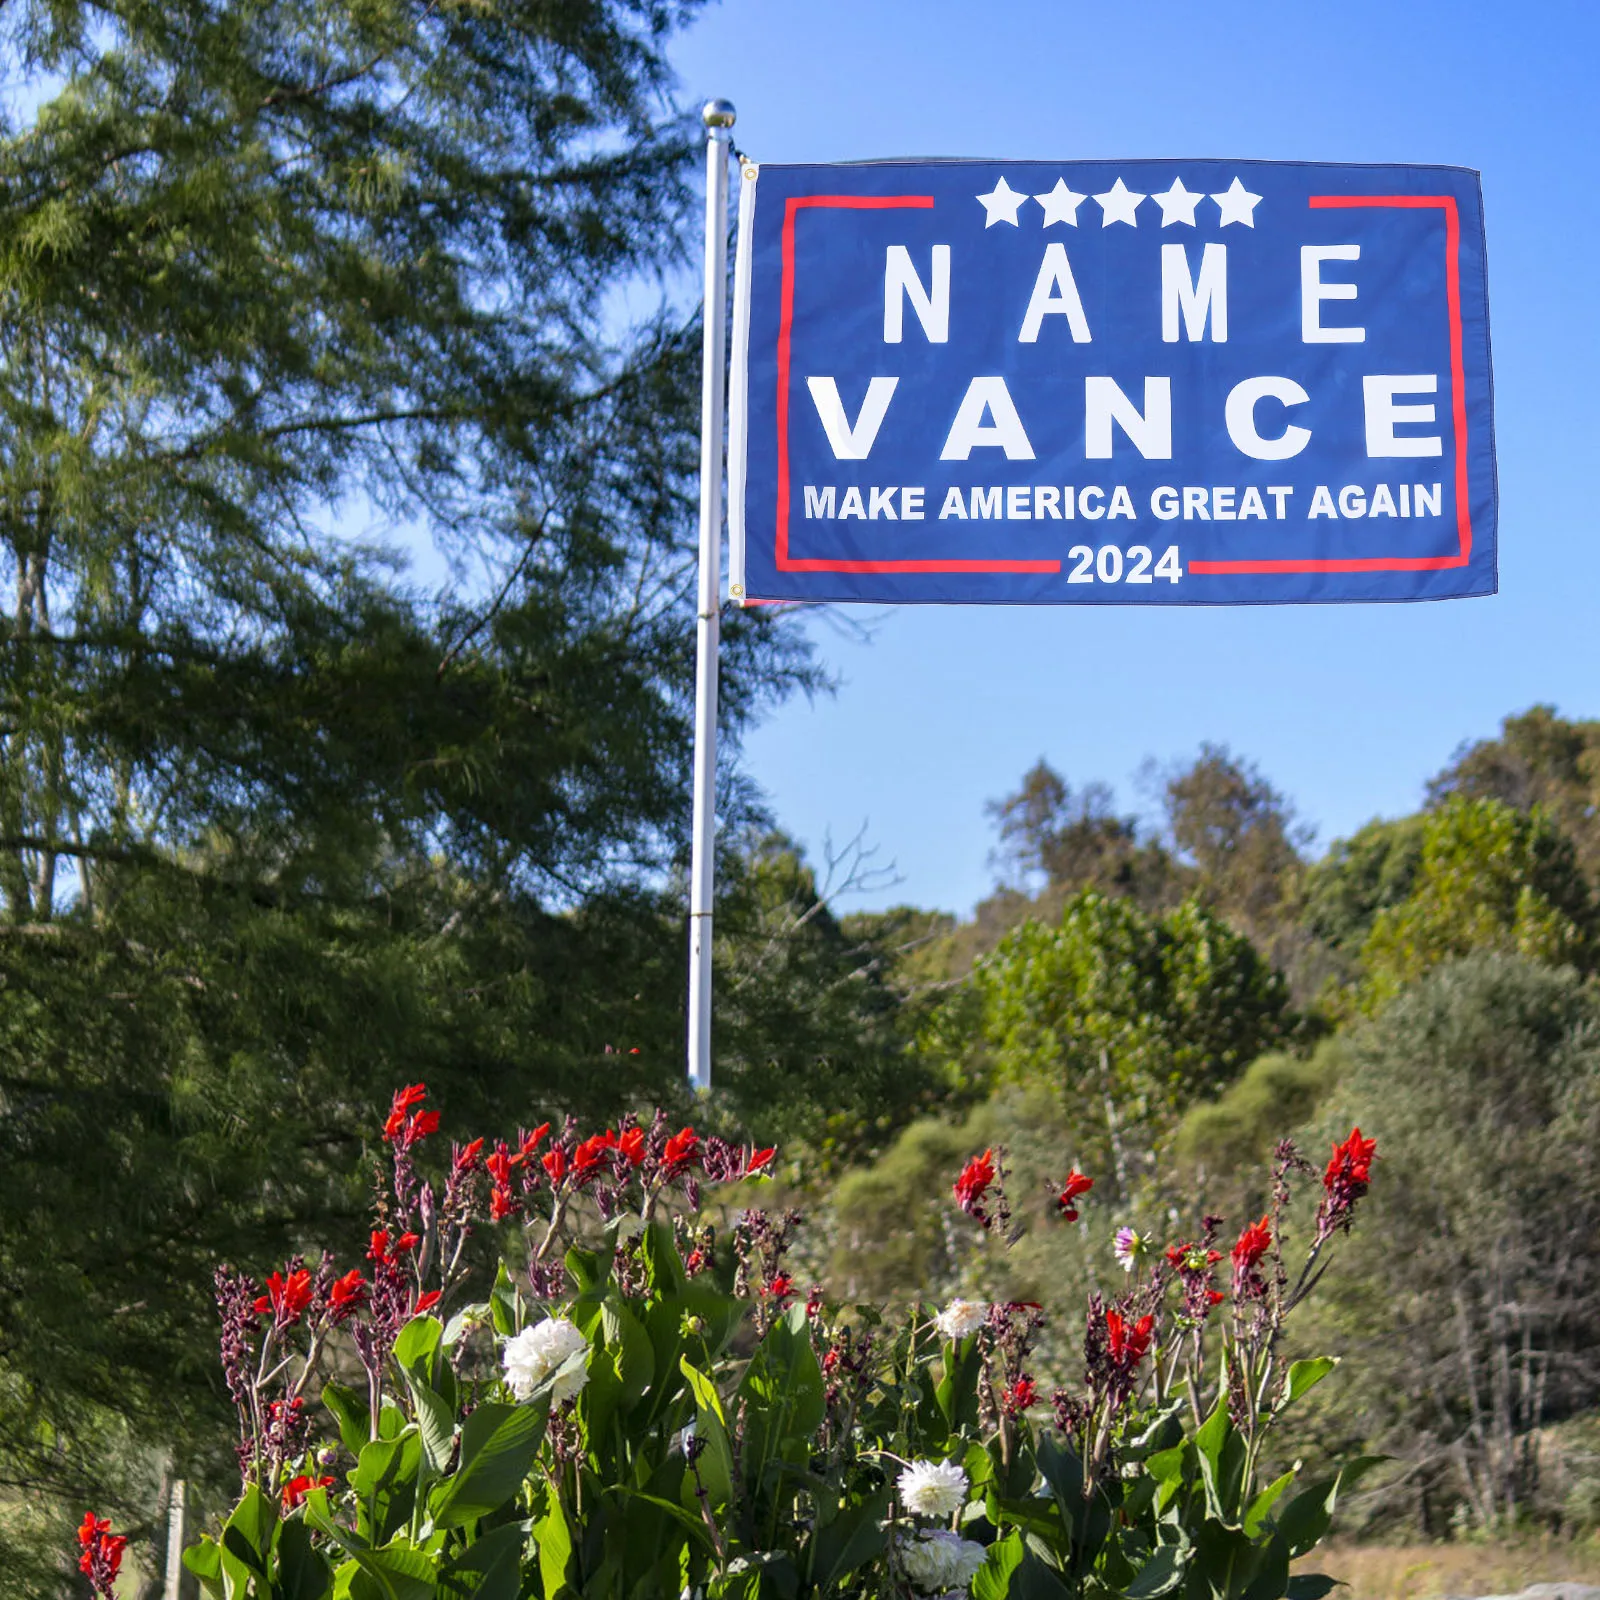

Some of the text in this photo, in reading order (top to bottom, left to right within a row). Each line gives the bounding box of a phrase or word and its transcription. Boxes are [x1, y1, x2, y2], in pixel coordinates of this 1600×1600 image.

[884, 243, 1366, 344] NAME
[807, 374, 1443, 461] VANCE
[803, 482, 1442, 521] MAKE AMERICA GREAT AGAIN
[1066, 544, 1183, 585] 2024
